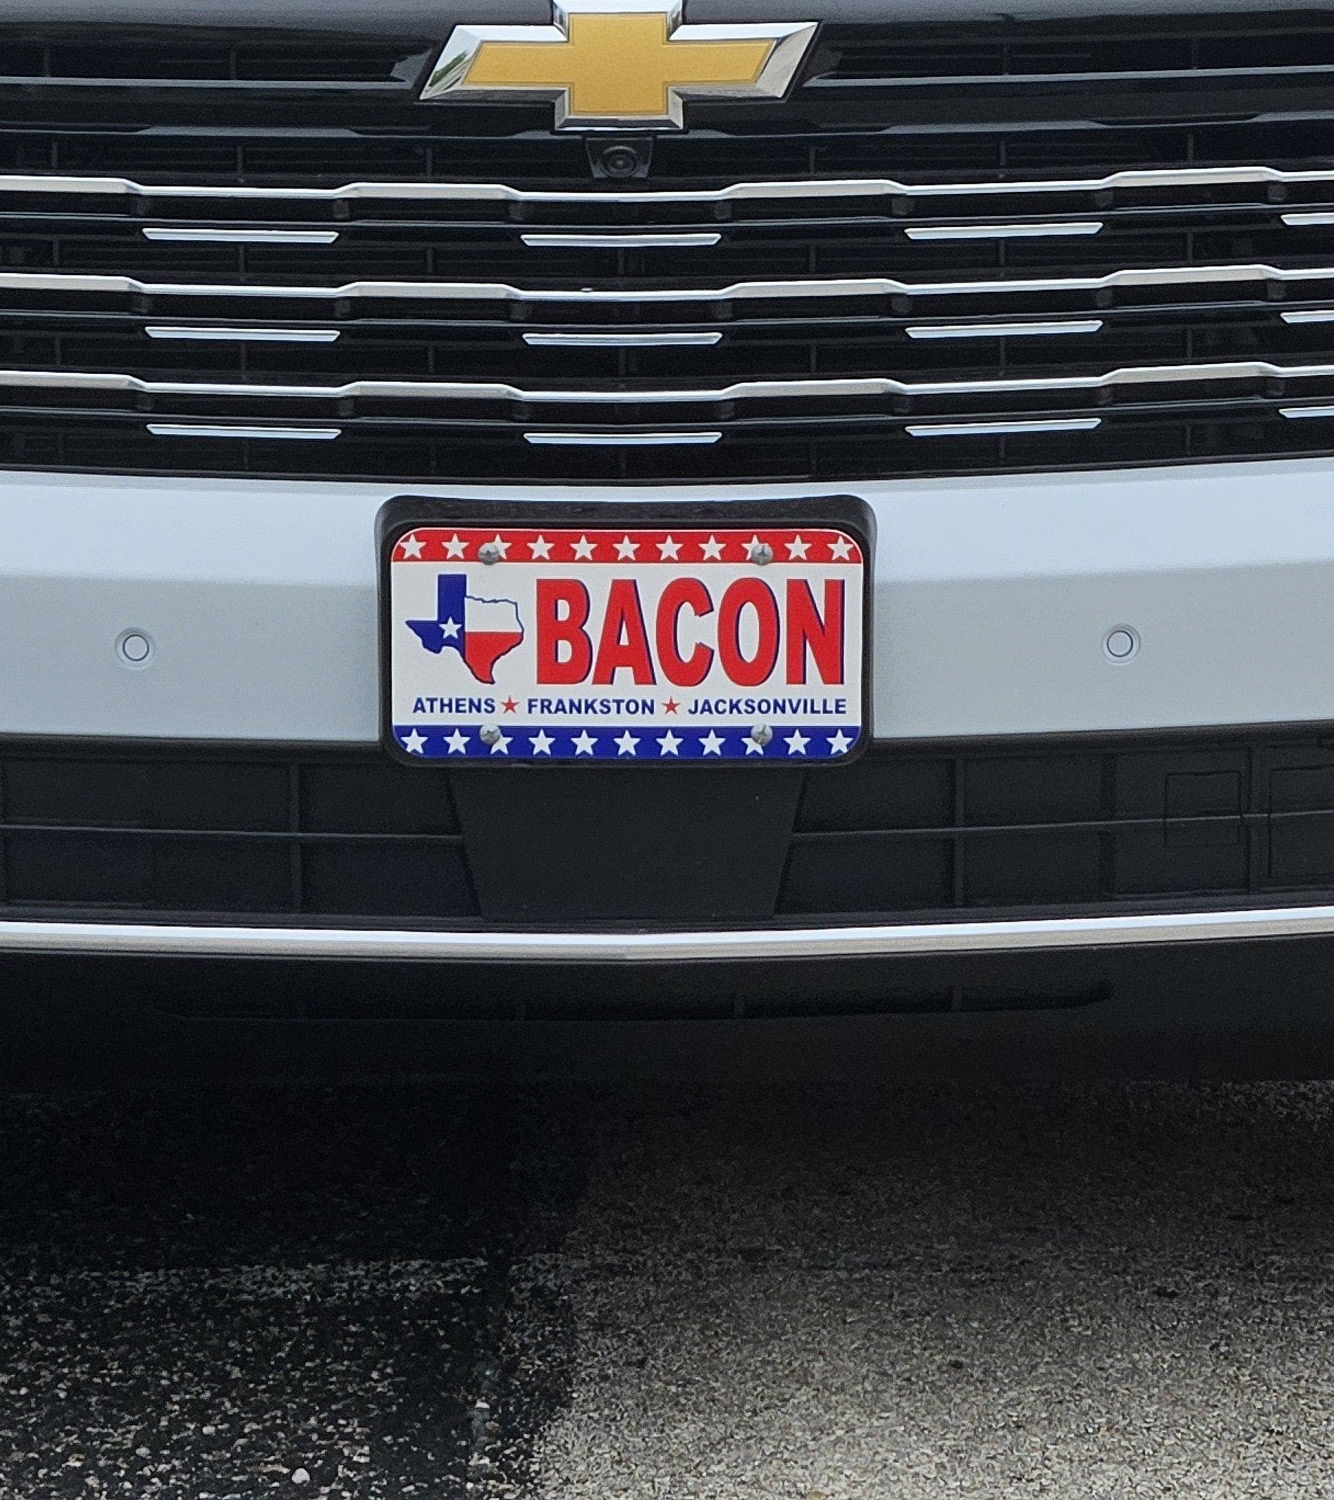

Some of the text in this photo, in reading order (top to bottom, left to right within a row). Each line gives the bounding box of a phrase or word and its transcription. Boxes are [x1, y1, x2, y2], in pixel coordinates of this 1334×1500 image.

[536, 577, 845, 687] BACON
[412, 697, 847, 715] ATHENS FRANKSTON JACKSONVILLE
